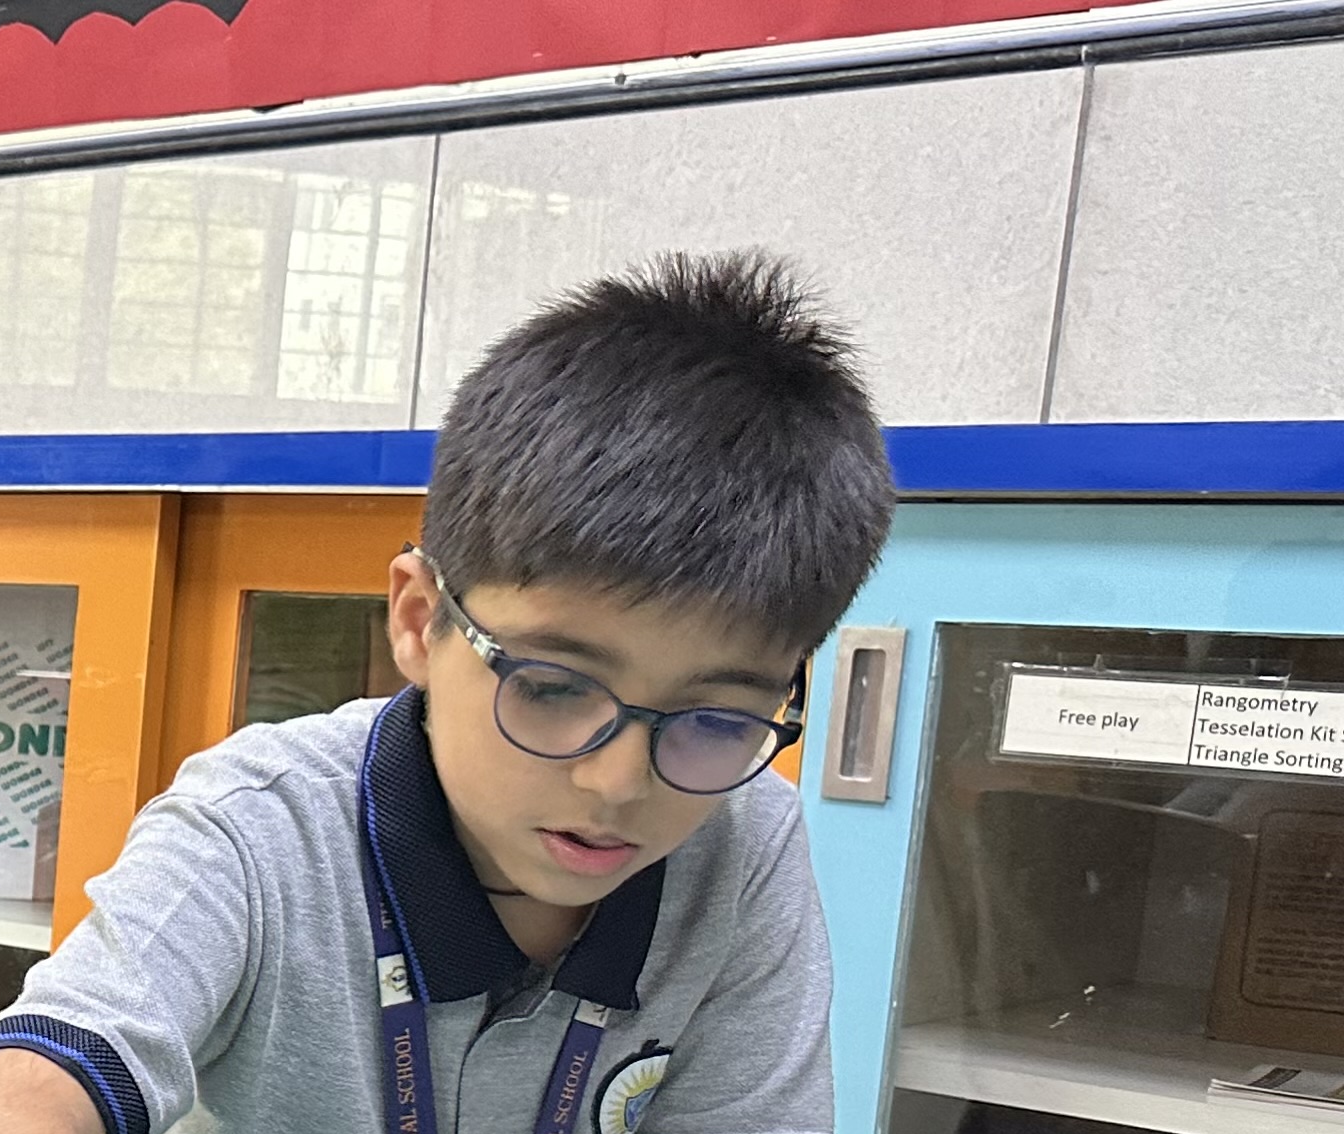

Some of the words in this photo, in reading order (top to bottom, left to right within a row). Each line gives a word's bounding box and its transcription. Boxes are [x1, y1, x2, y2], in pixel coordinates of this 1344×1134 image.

[1201, 691, 1319, 717] Rangometry
[1059, 709, 1097, 726] Free
[1101, 712, 1140, 732] play
[1198, 718, 1304, 740] Tesselation
[1310, 725, 1337, 742] Kit
[1194, 744, 1269, 767] Triangle
[1274, 750, 1344, 774] Sorting
[393, 1028, 416, 1105] SCHOOL
[553, 1050, 589, 1133] SCHOOL
